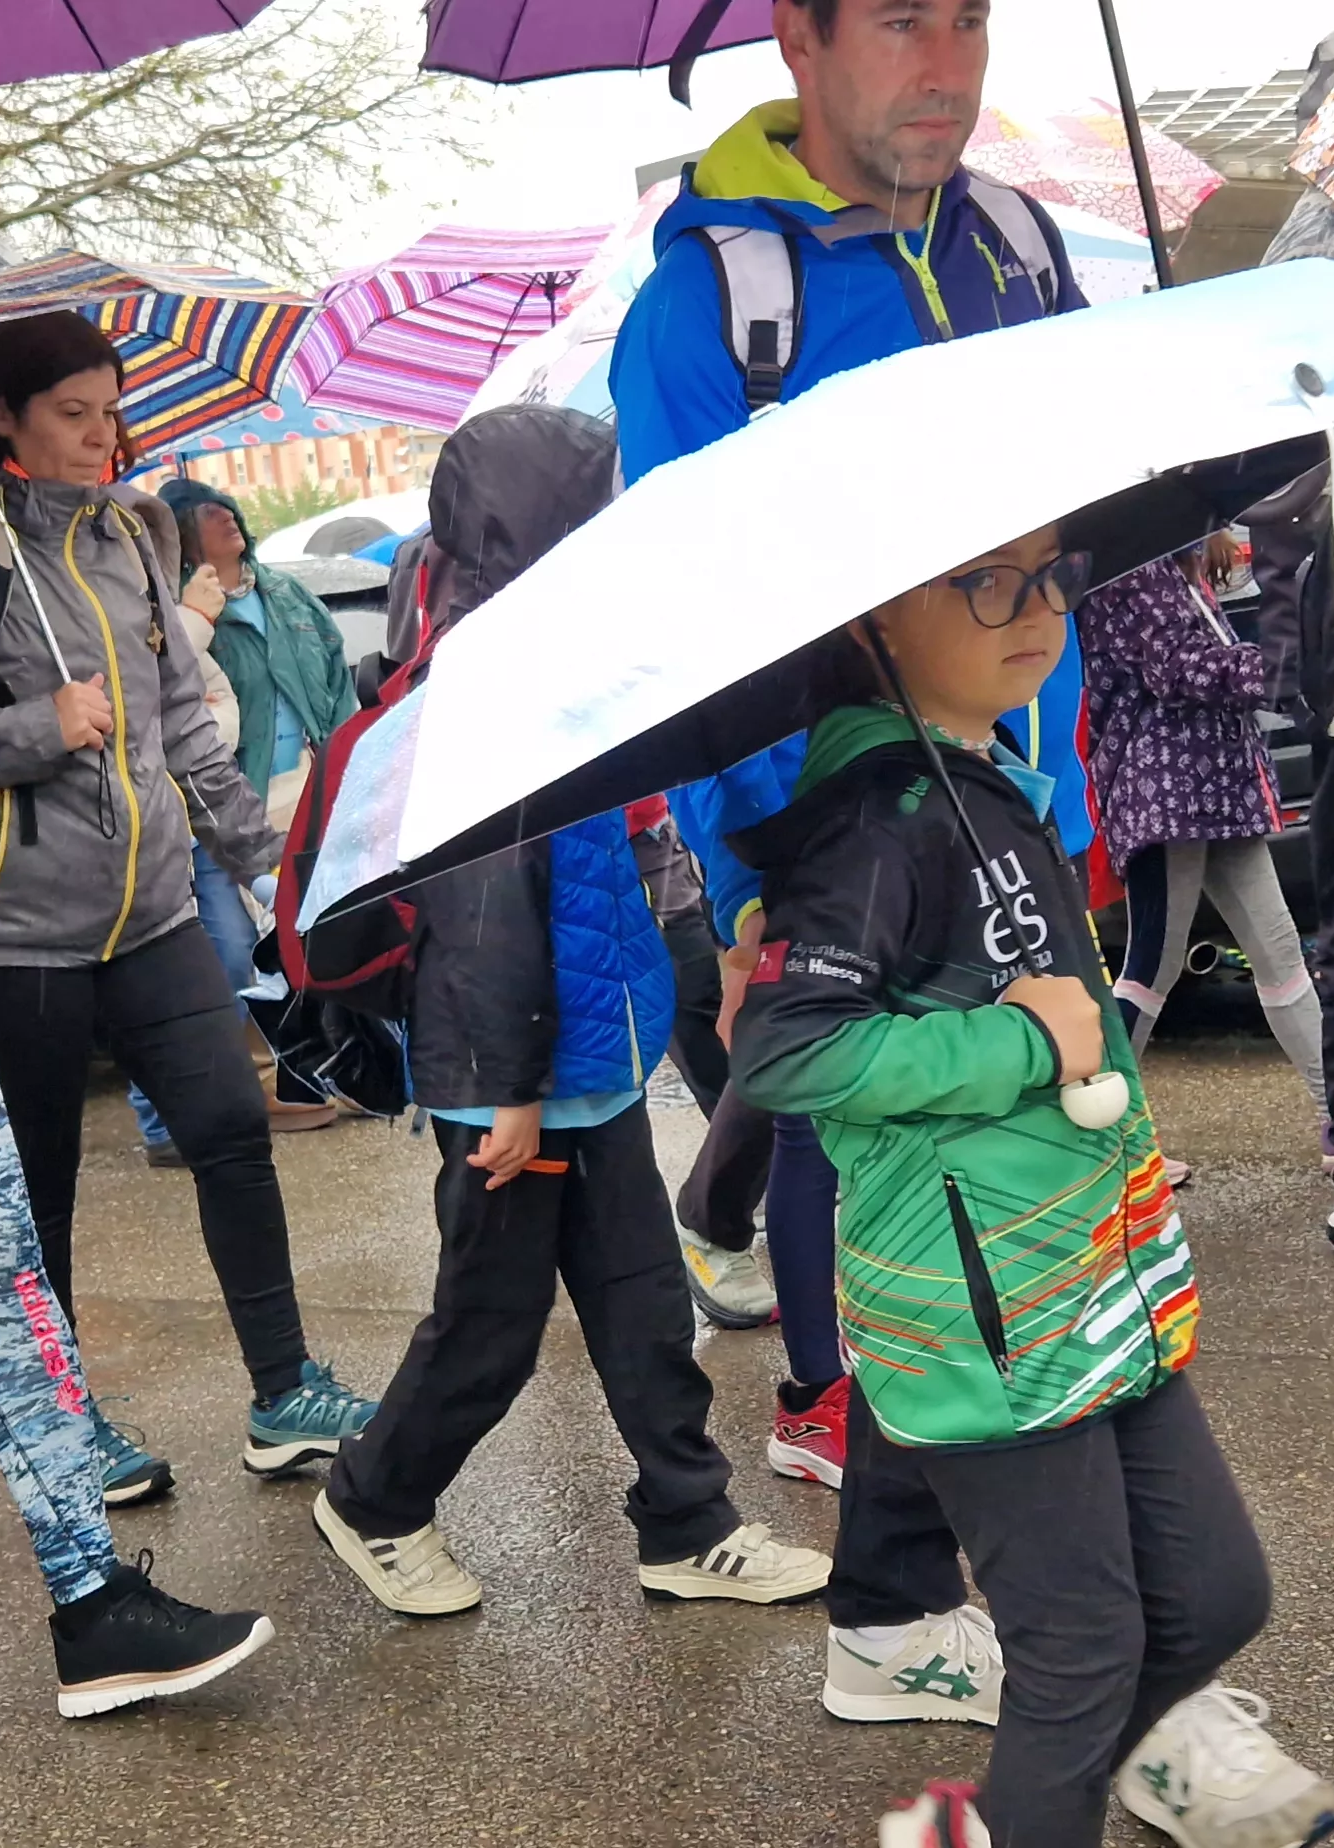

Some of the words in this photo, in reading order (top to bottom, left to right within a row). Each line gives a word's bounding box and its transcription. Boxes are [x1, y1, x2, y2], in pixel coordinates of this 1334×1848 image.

[785, 958, 807, 974] de
[808, 957, 864, 985] Huesca
[13, 1270, 69, 1379] adidas
